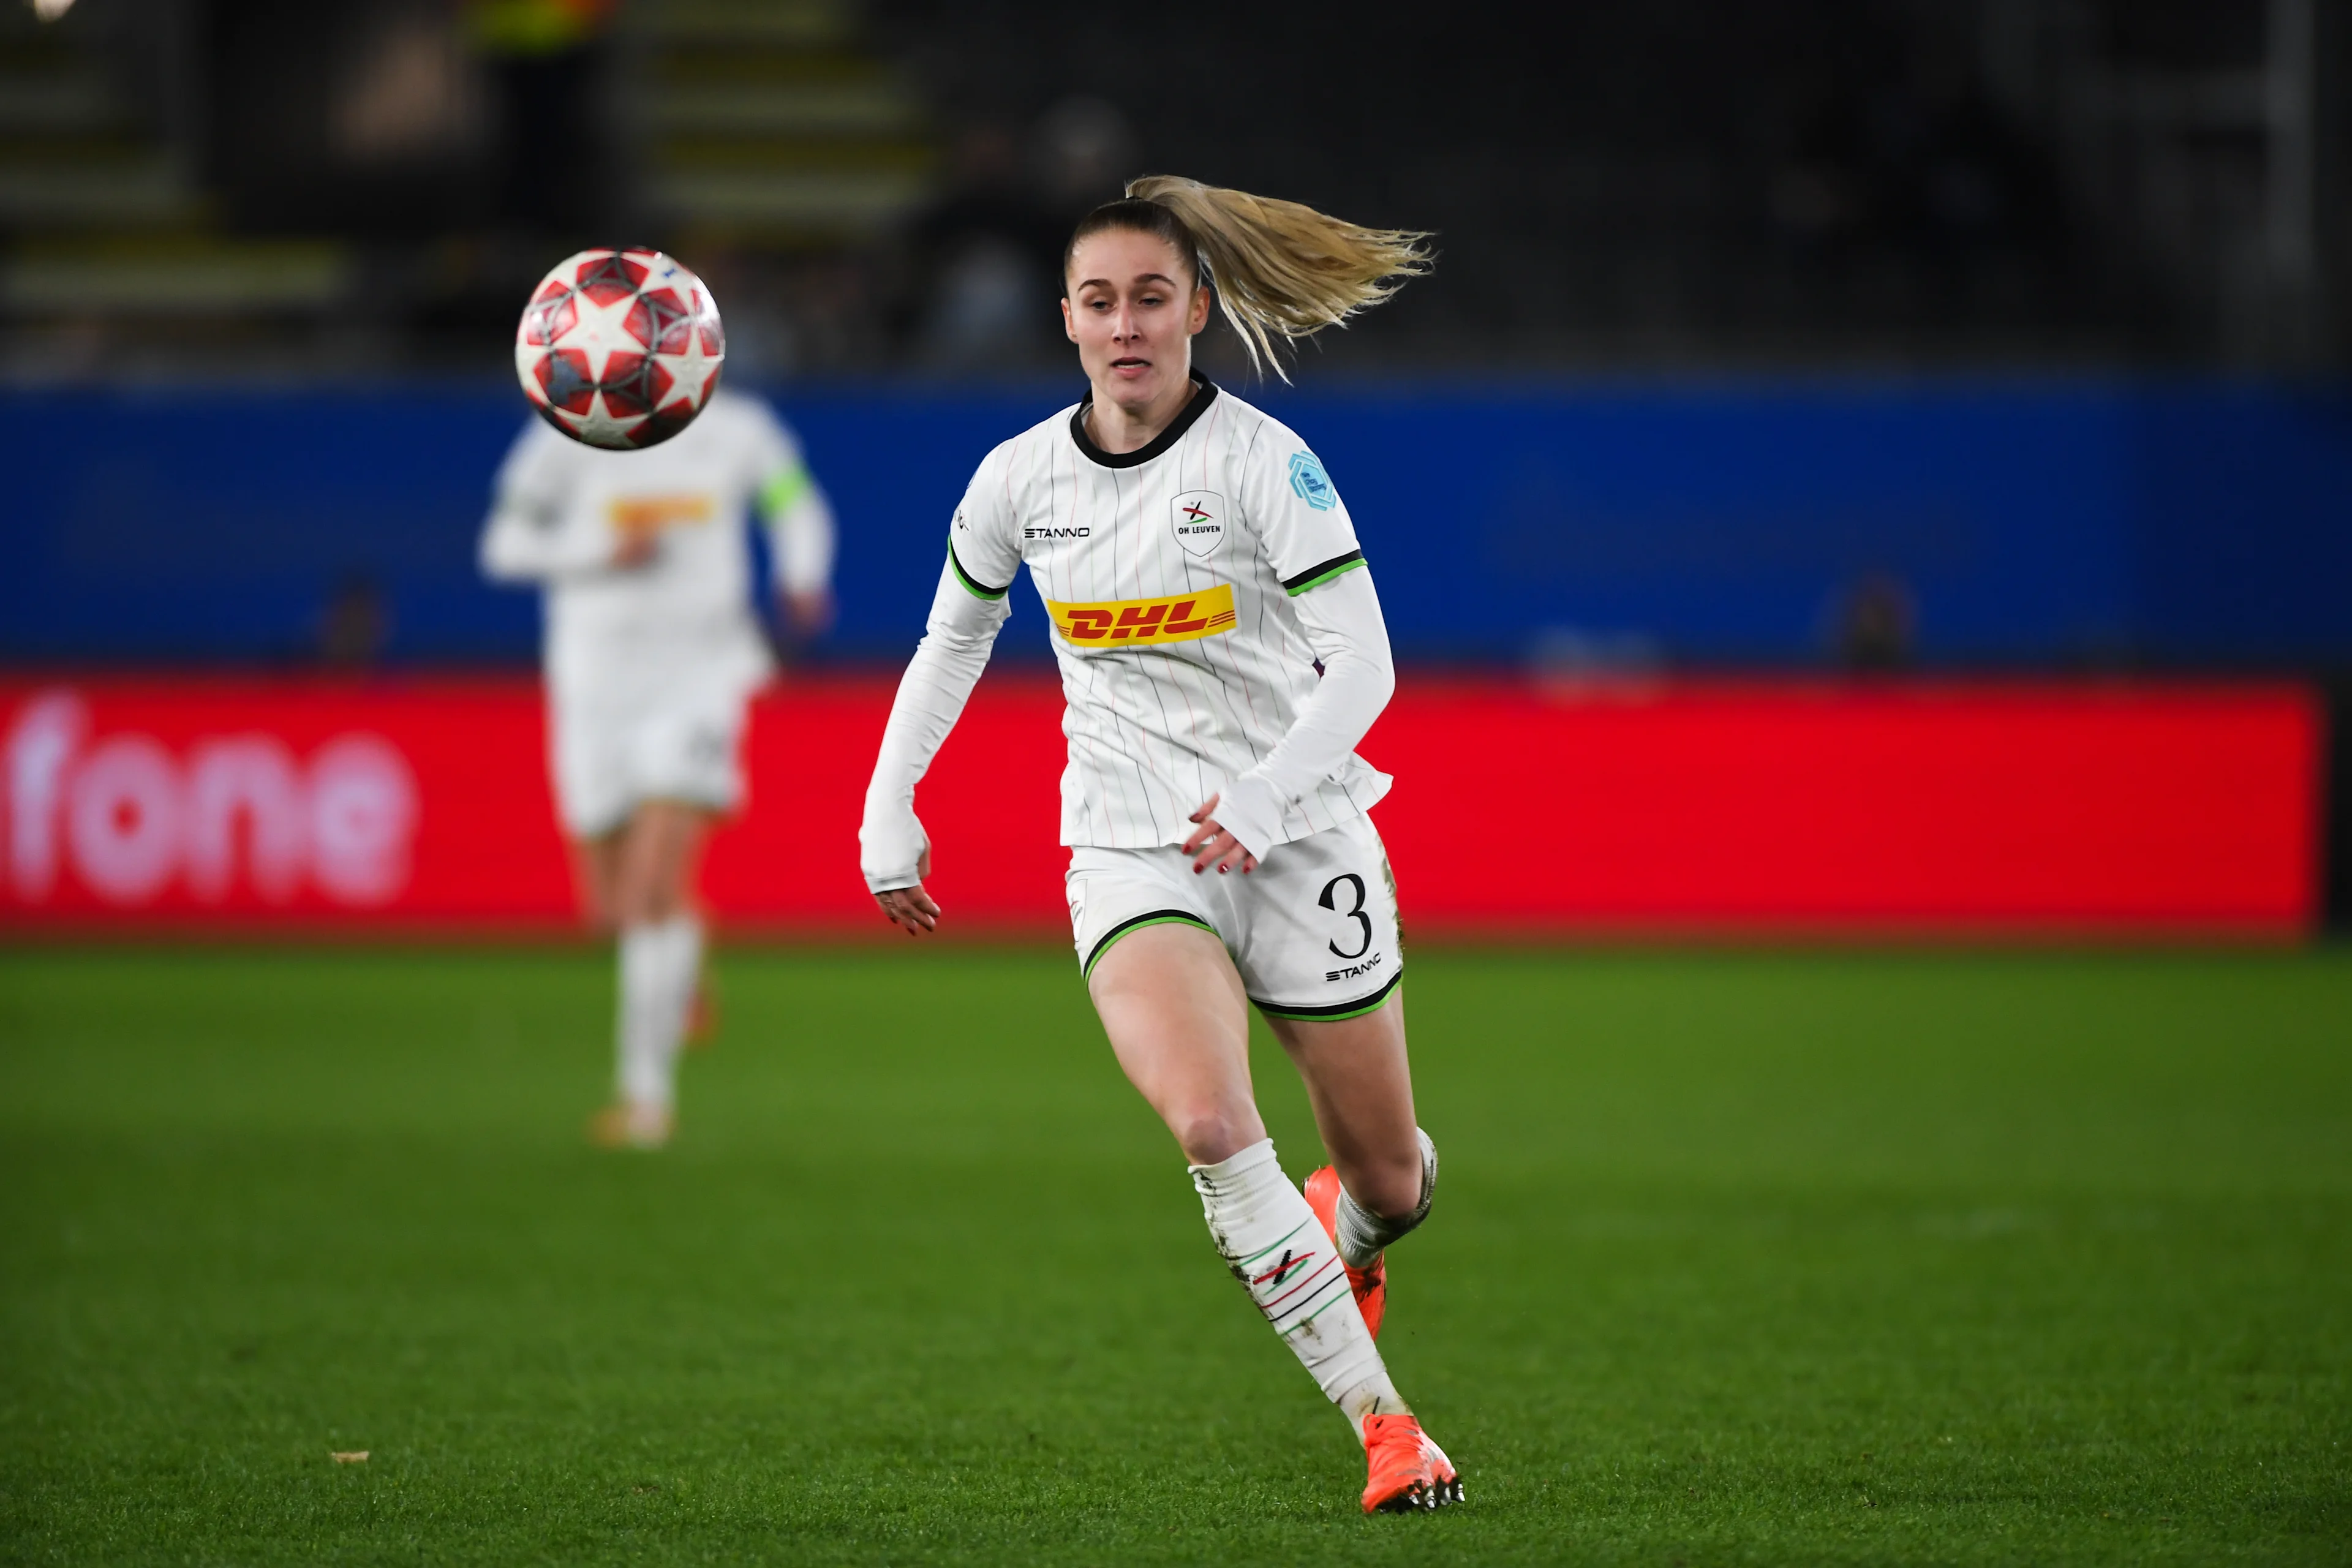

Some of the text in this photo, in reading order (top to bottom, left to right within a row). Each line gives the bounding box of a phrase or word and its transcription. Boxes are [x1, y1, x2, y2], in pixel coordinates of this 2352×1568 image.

[1024, 527, 1090, 538] STANNO
[1193, 525, 1221, 533] LEUVEN
[1068, 600, 1208, 639] DHL
[1318, 873, 1371, 959] 3
